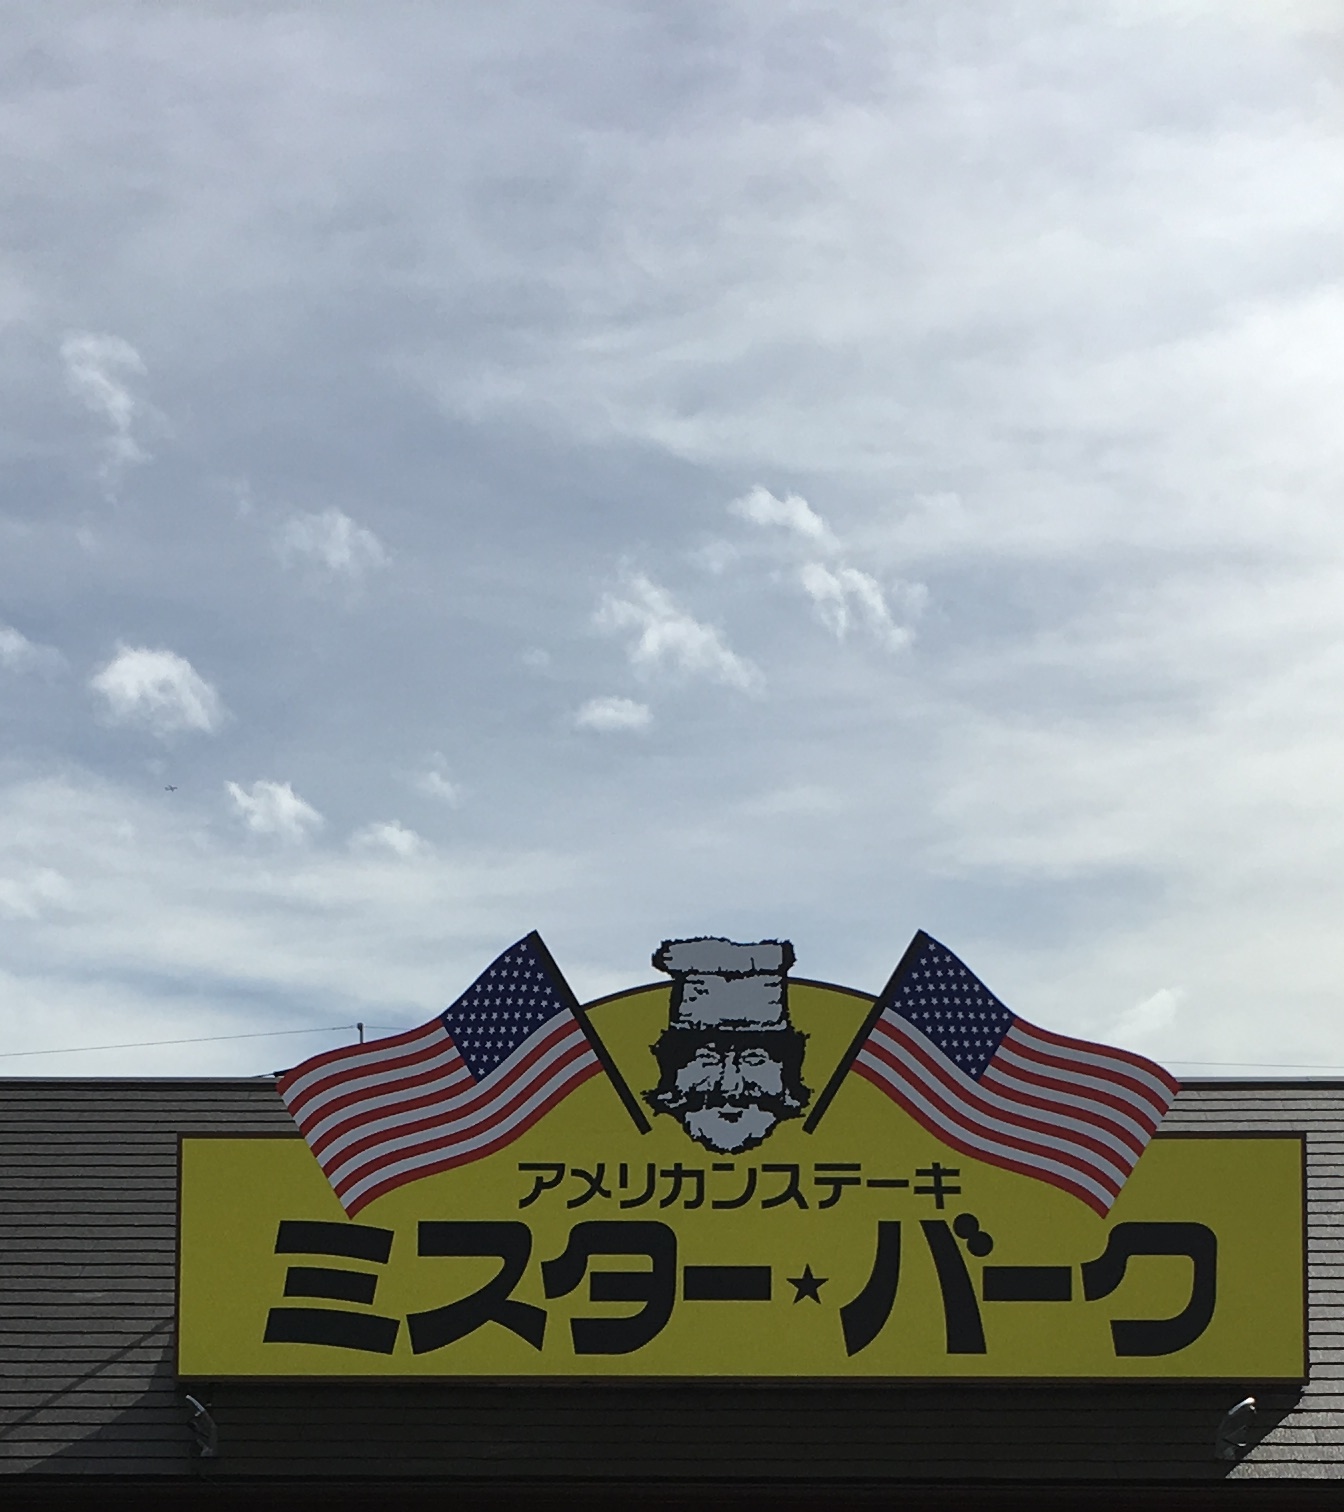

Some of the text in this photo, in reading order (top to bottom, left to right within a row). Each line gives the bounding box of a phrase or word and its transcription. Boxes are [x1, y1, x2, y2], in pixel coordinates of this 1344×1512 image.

[518, 1162, 962, 1210] アメリカンステーキ
